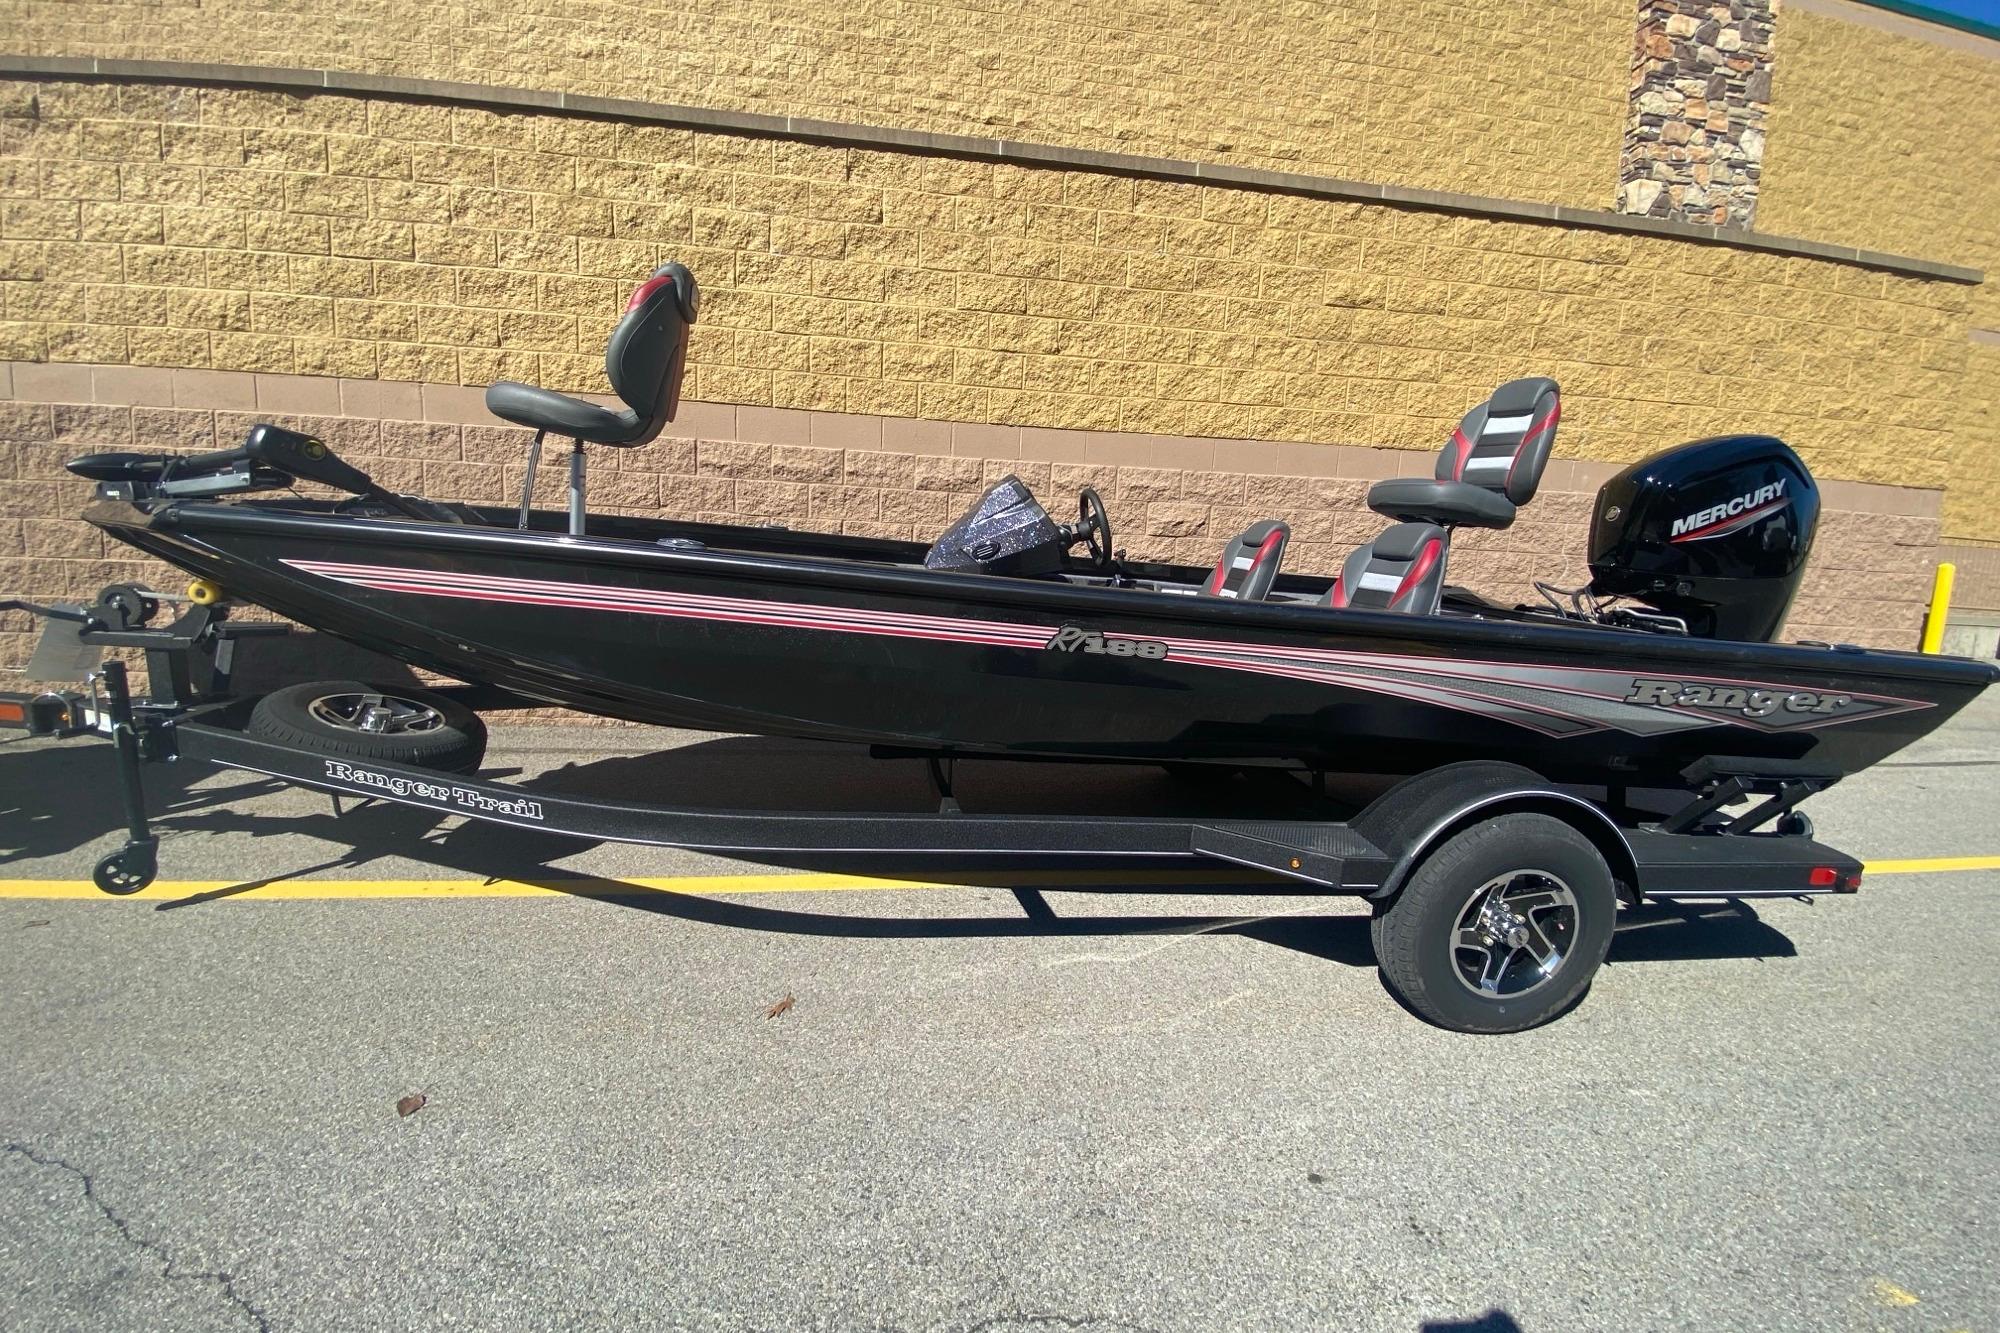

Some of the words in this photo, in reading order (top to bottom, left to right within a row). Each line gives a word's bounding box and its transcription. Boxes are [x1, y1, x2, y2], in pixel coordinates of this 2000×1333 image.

[1671, 478, 1786, 537] MERCURY
[1624, 678, 1851, 716] Ranger
[325, 761, 449, 801] Ranger
[452, 788, 544, 820] Trail
